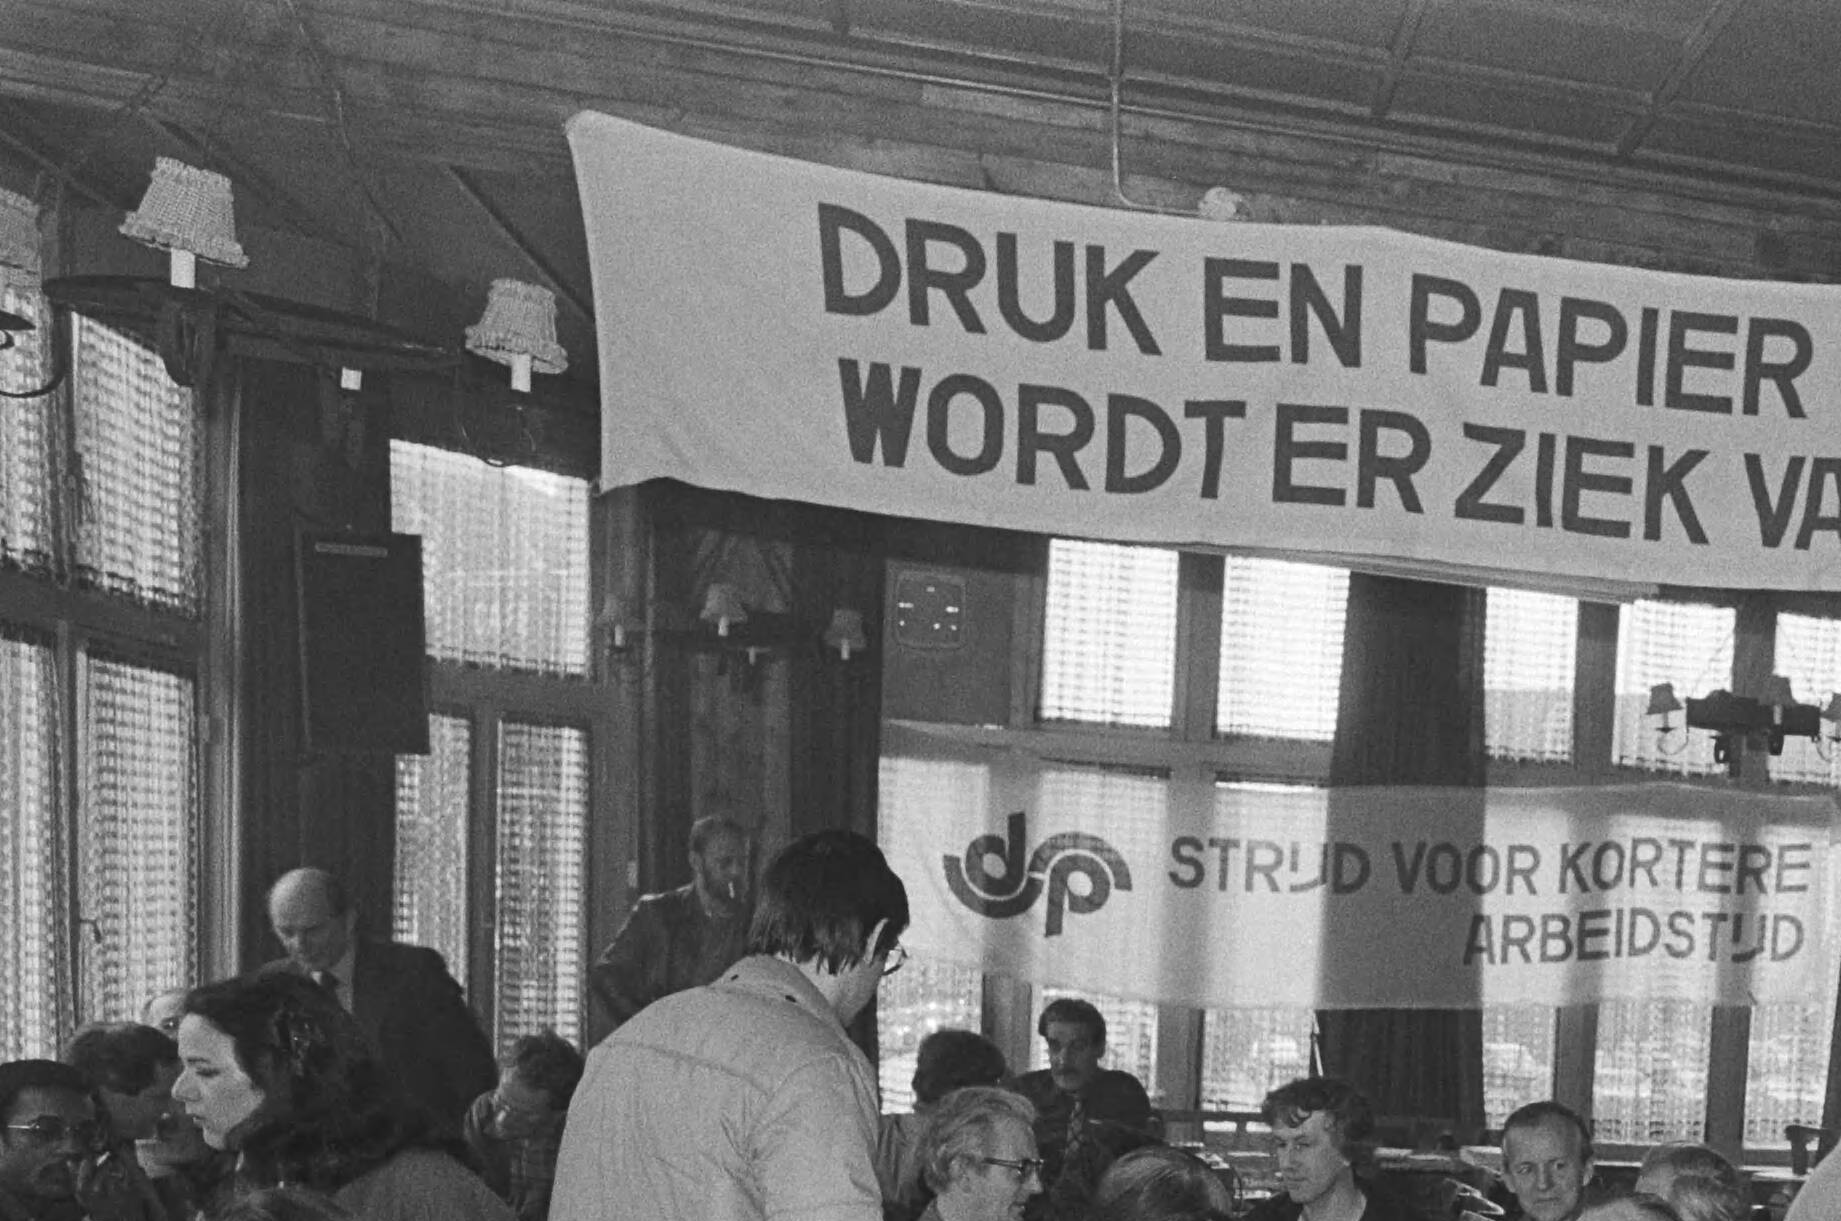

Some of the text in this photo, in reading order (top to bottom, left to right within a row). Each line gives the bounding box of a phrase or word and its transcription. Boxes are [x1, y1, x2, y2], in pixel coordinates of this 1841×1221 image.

[818, 202, 1815, 420] DRUK EN PAPIER
[837, 356, 1247, 499] WORDT
[1272, 401, 1432, 515] ER
[1453, 421, 1712, 546] ZIEK
[1168, 836, 1813, 896] STRIJD VOOR KORTERE
[1462, 906, 1805, 966] ARBEIDSTIJD
